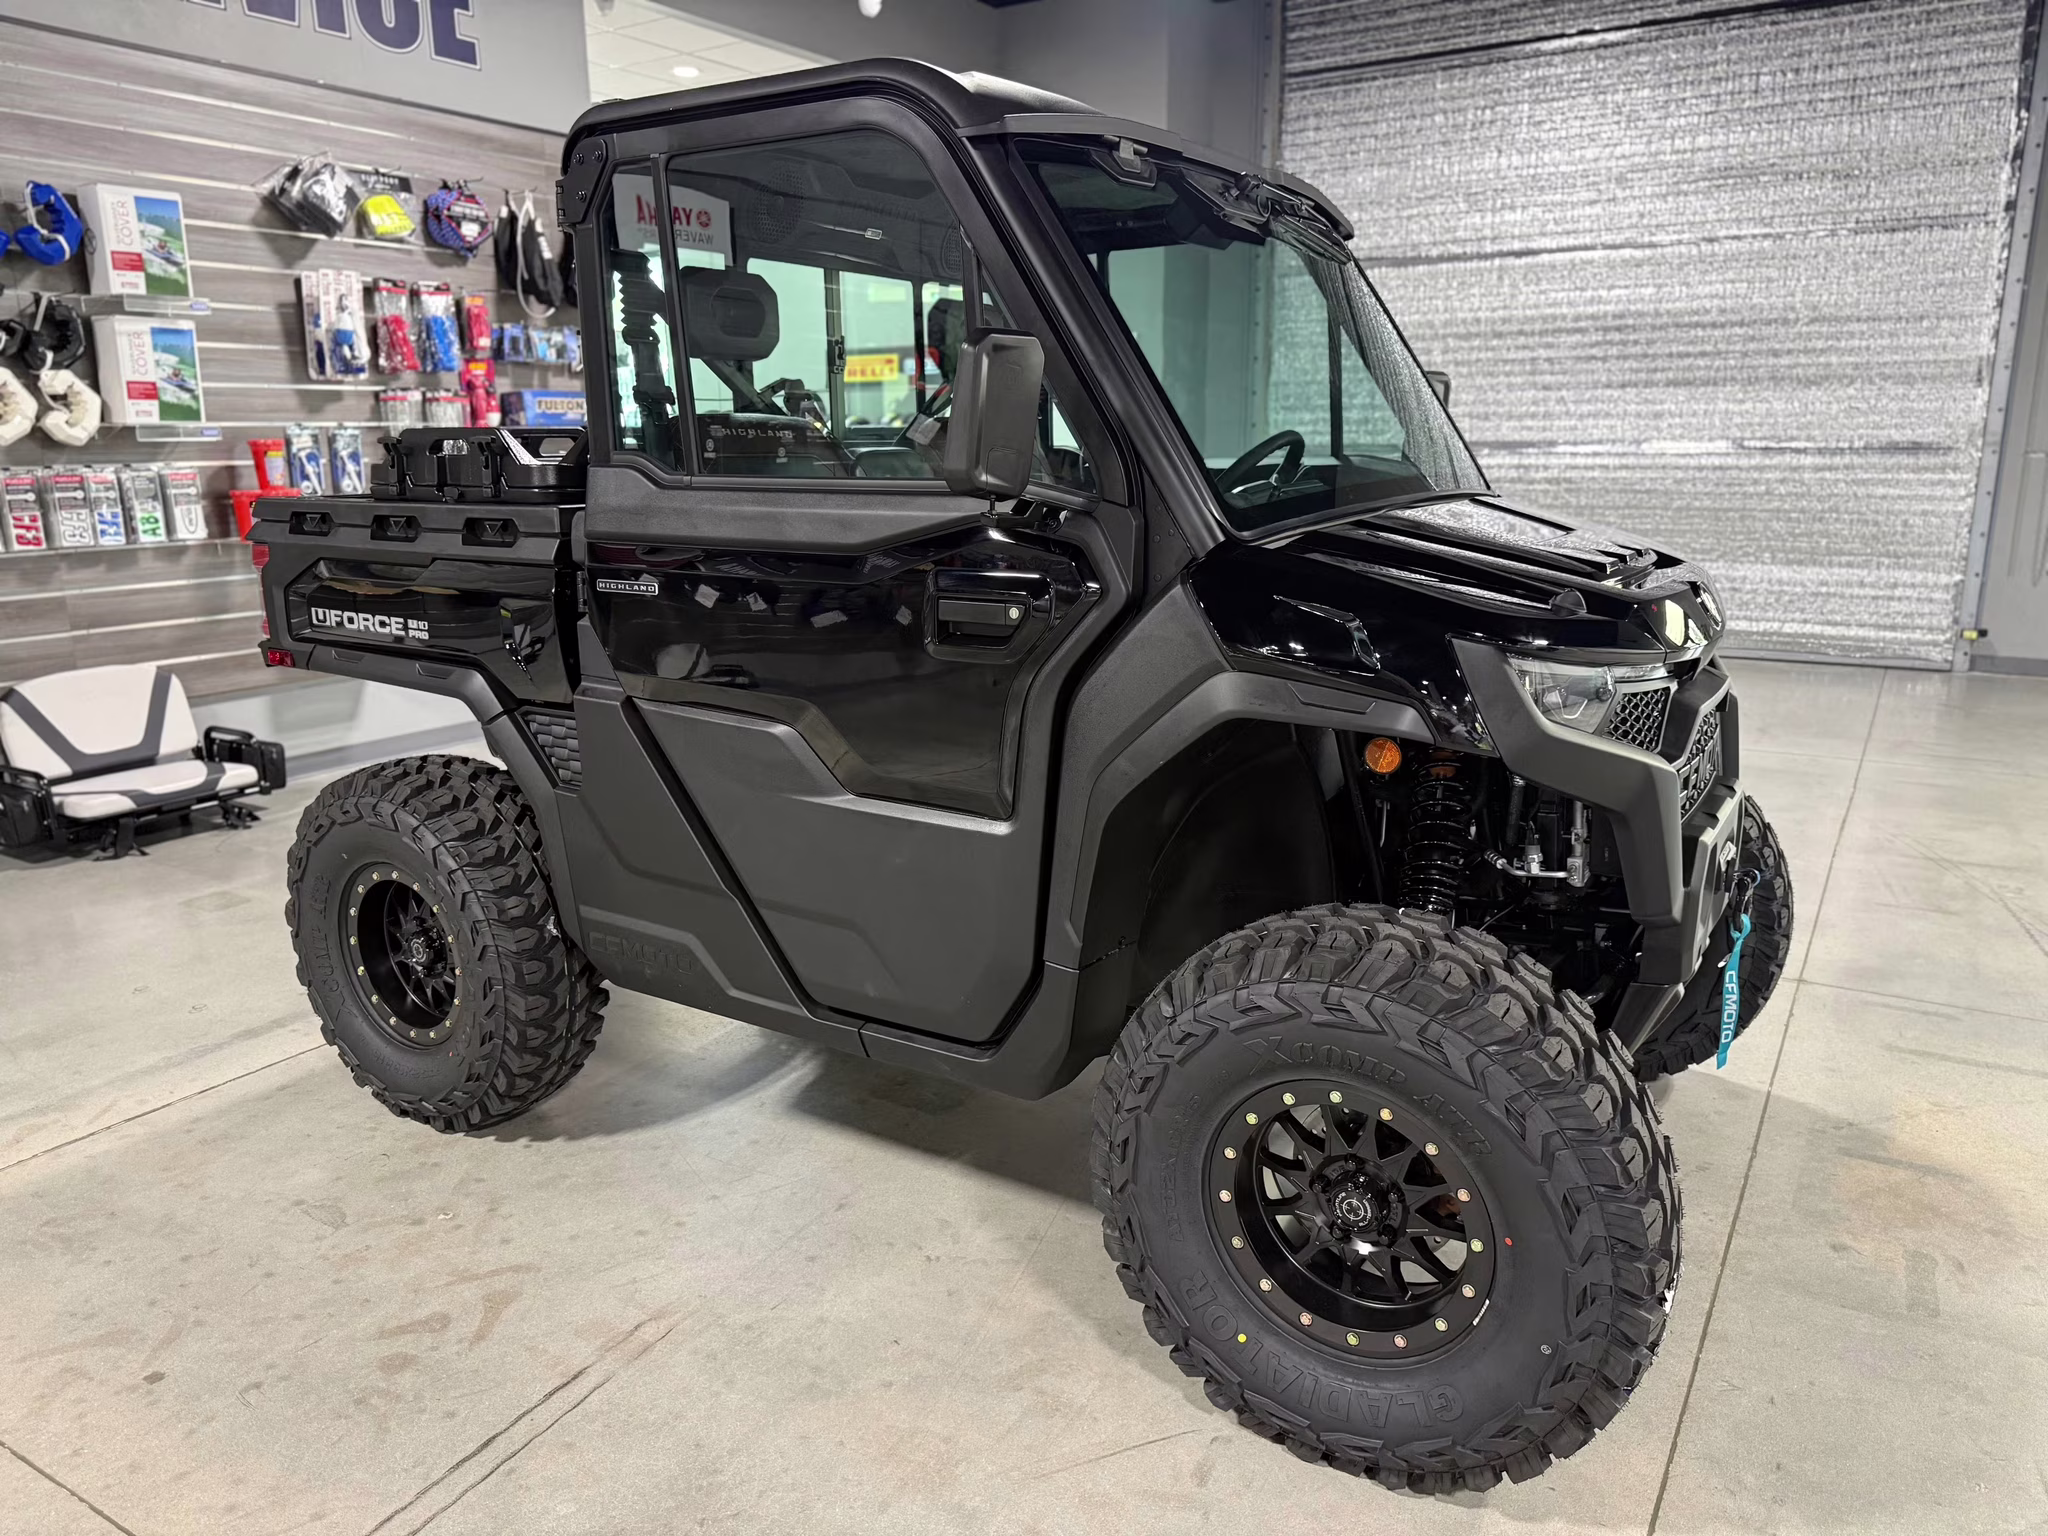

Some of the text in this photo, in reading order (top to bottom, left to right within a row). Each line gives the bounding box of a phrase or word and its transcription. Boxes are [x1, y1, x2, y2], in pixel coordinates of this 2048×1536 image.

[117, 200, 134, 247] COVER
[133, 331, 148, 377] COVER
[537, 400, 584, 411] FULTON
[722, 428, 794, 439] HIGHLAND
[599, 582, 655, 593] HIGHLAND
[311, 607, 406, 636] UFORCE
[408, 629, 430, 640] PRO
[1721, 970, 1739, 1044] CFMOTO
[1179, 1269, 1464, 1428] GLADIATOR
